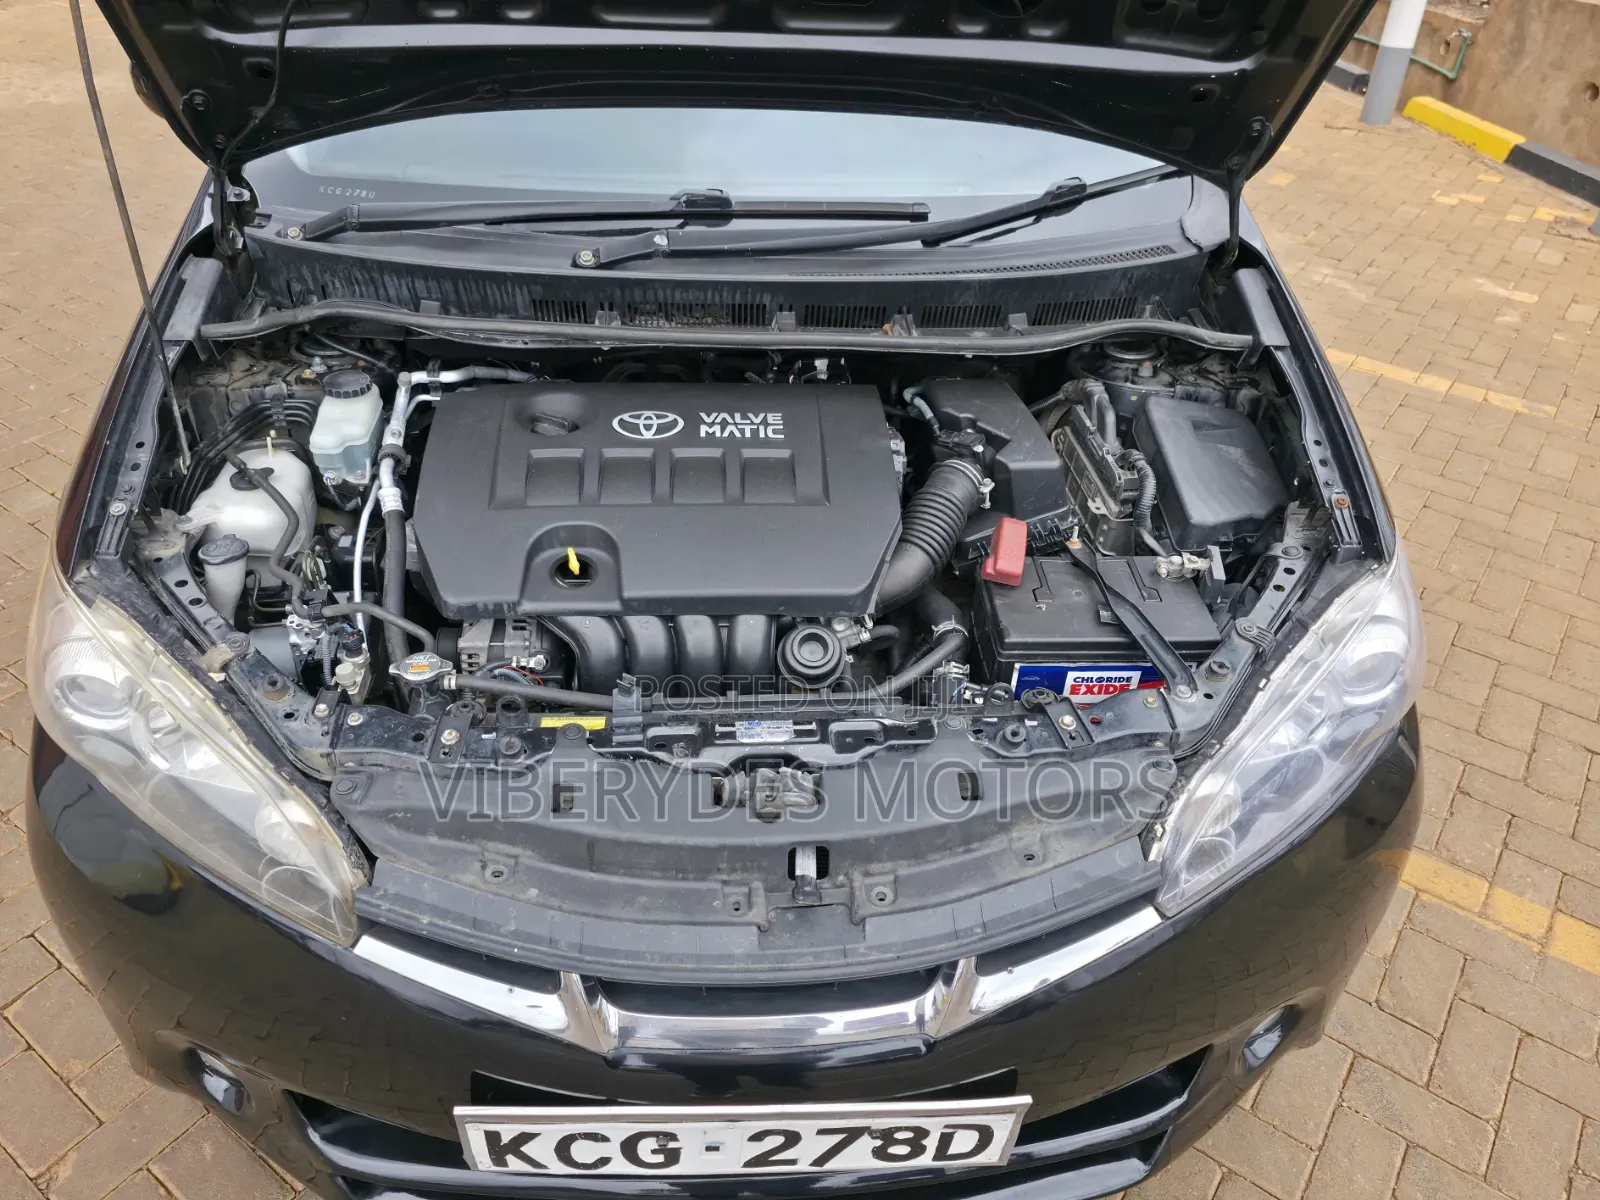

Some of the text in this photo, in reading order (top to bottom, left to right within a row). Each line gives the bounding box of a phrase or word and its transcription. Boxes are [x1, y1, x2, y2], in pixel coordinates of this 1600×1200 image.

[319, 186, 342, 195] KCG
[698, 412, 783, 424] VALVE
[700, 425, 785, 438] MATIC
[1073, 676, 1133, 684] CHLORIDE
[1069, 684, 1131, 695] EXIDE
[484, 1124, 994, 1171] KCG 278D
